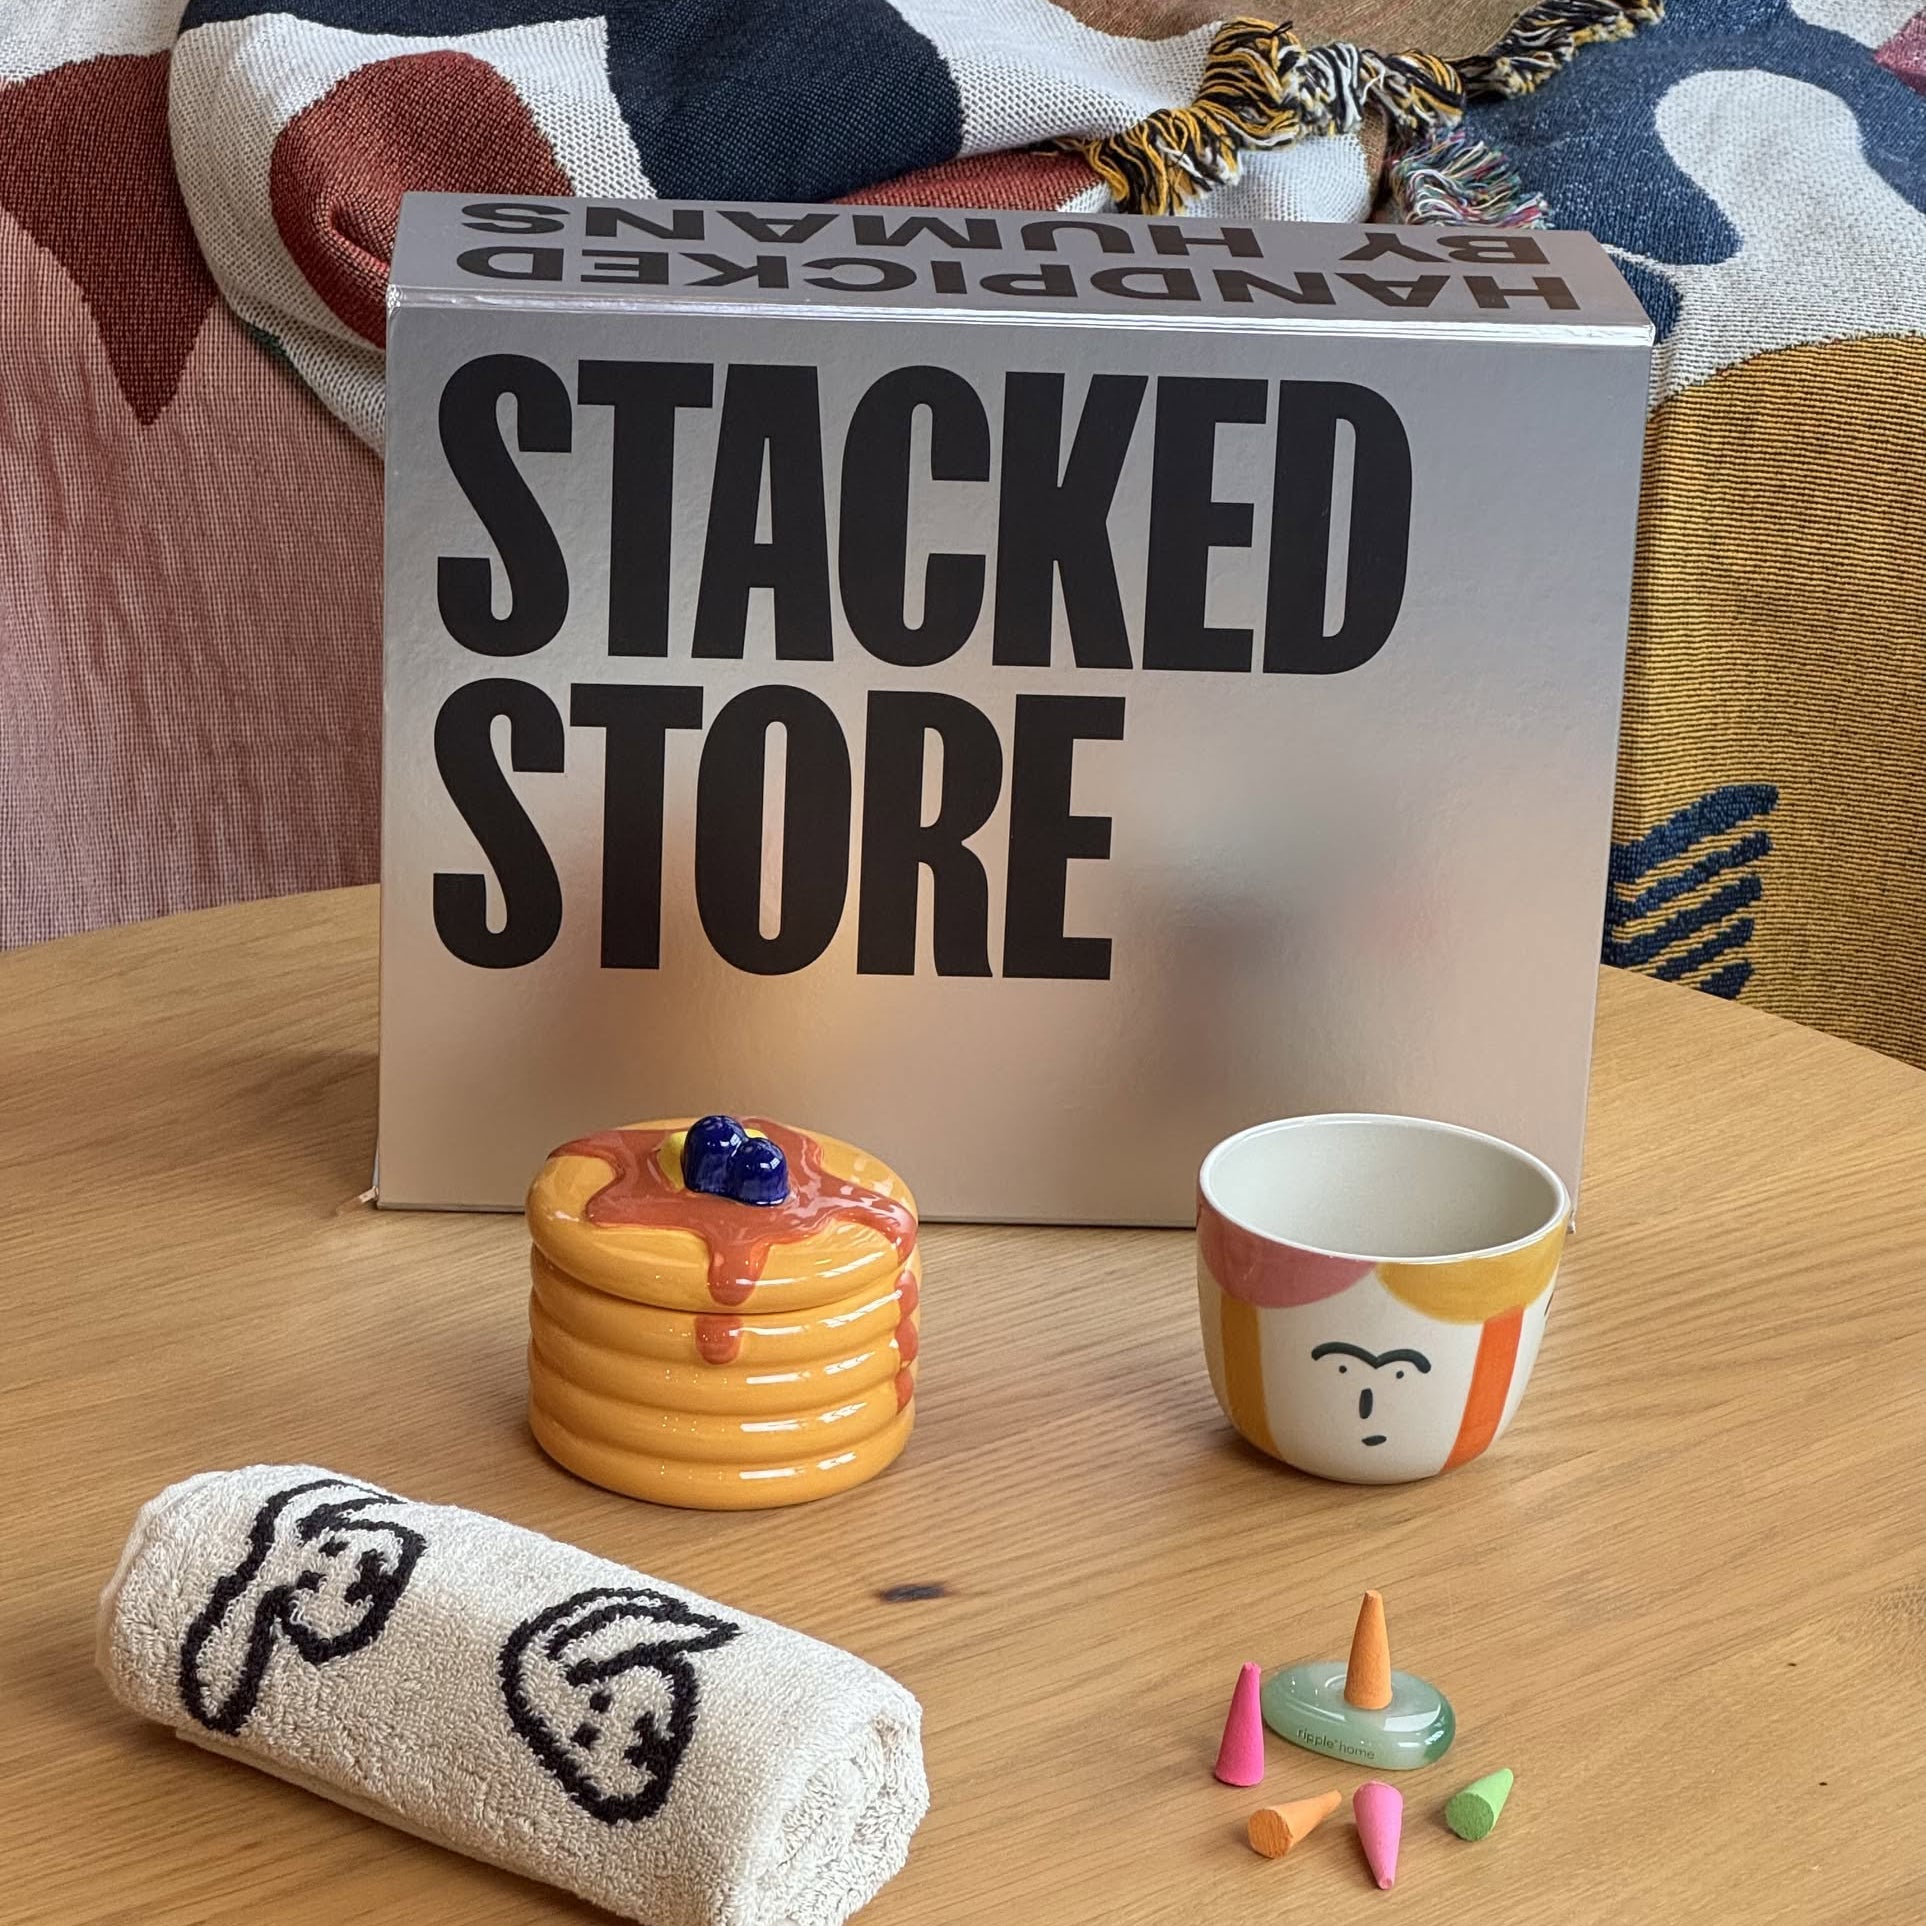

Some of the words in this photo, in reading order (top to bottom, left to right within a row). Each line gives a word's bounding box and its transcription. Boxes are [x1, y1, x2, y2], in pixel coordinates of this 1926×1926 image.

[460, 202, 1264, 258] HUMANS
[1338, 232, 1550, 264] BY
[457, 245, 1580, 310] HANDPICKED
[437, 354, 1412, 674] STACKED
[433, 678, 1125, 980] STORE
[1339, 1739, 1375, 1759] home
